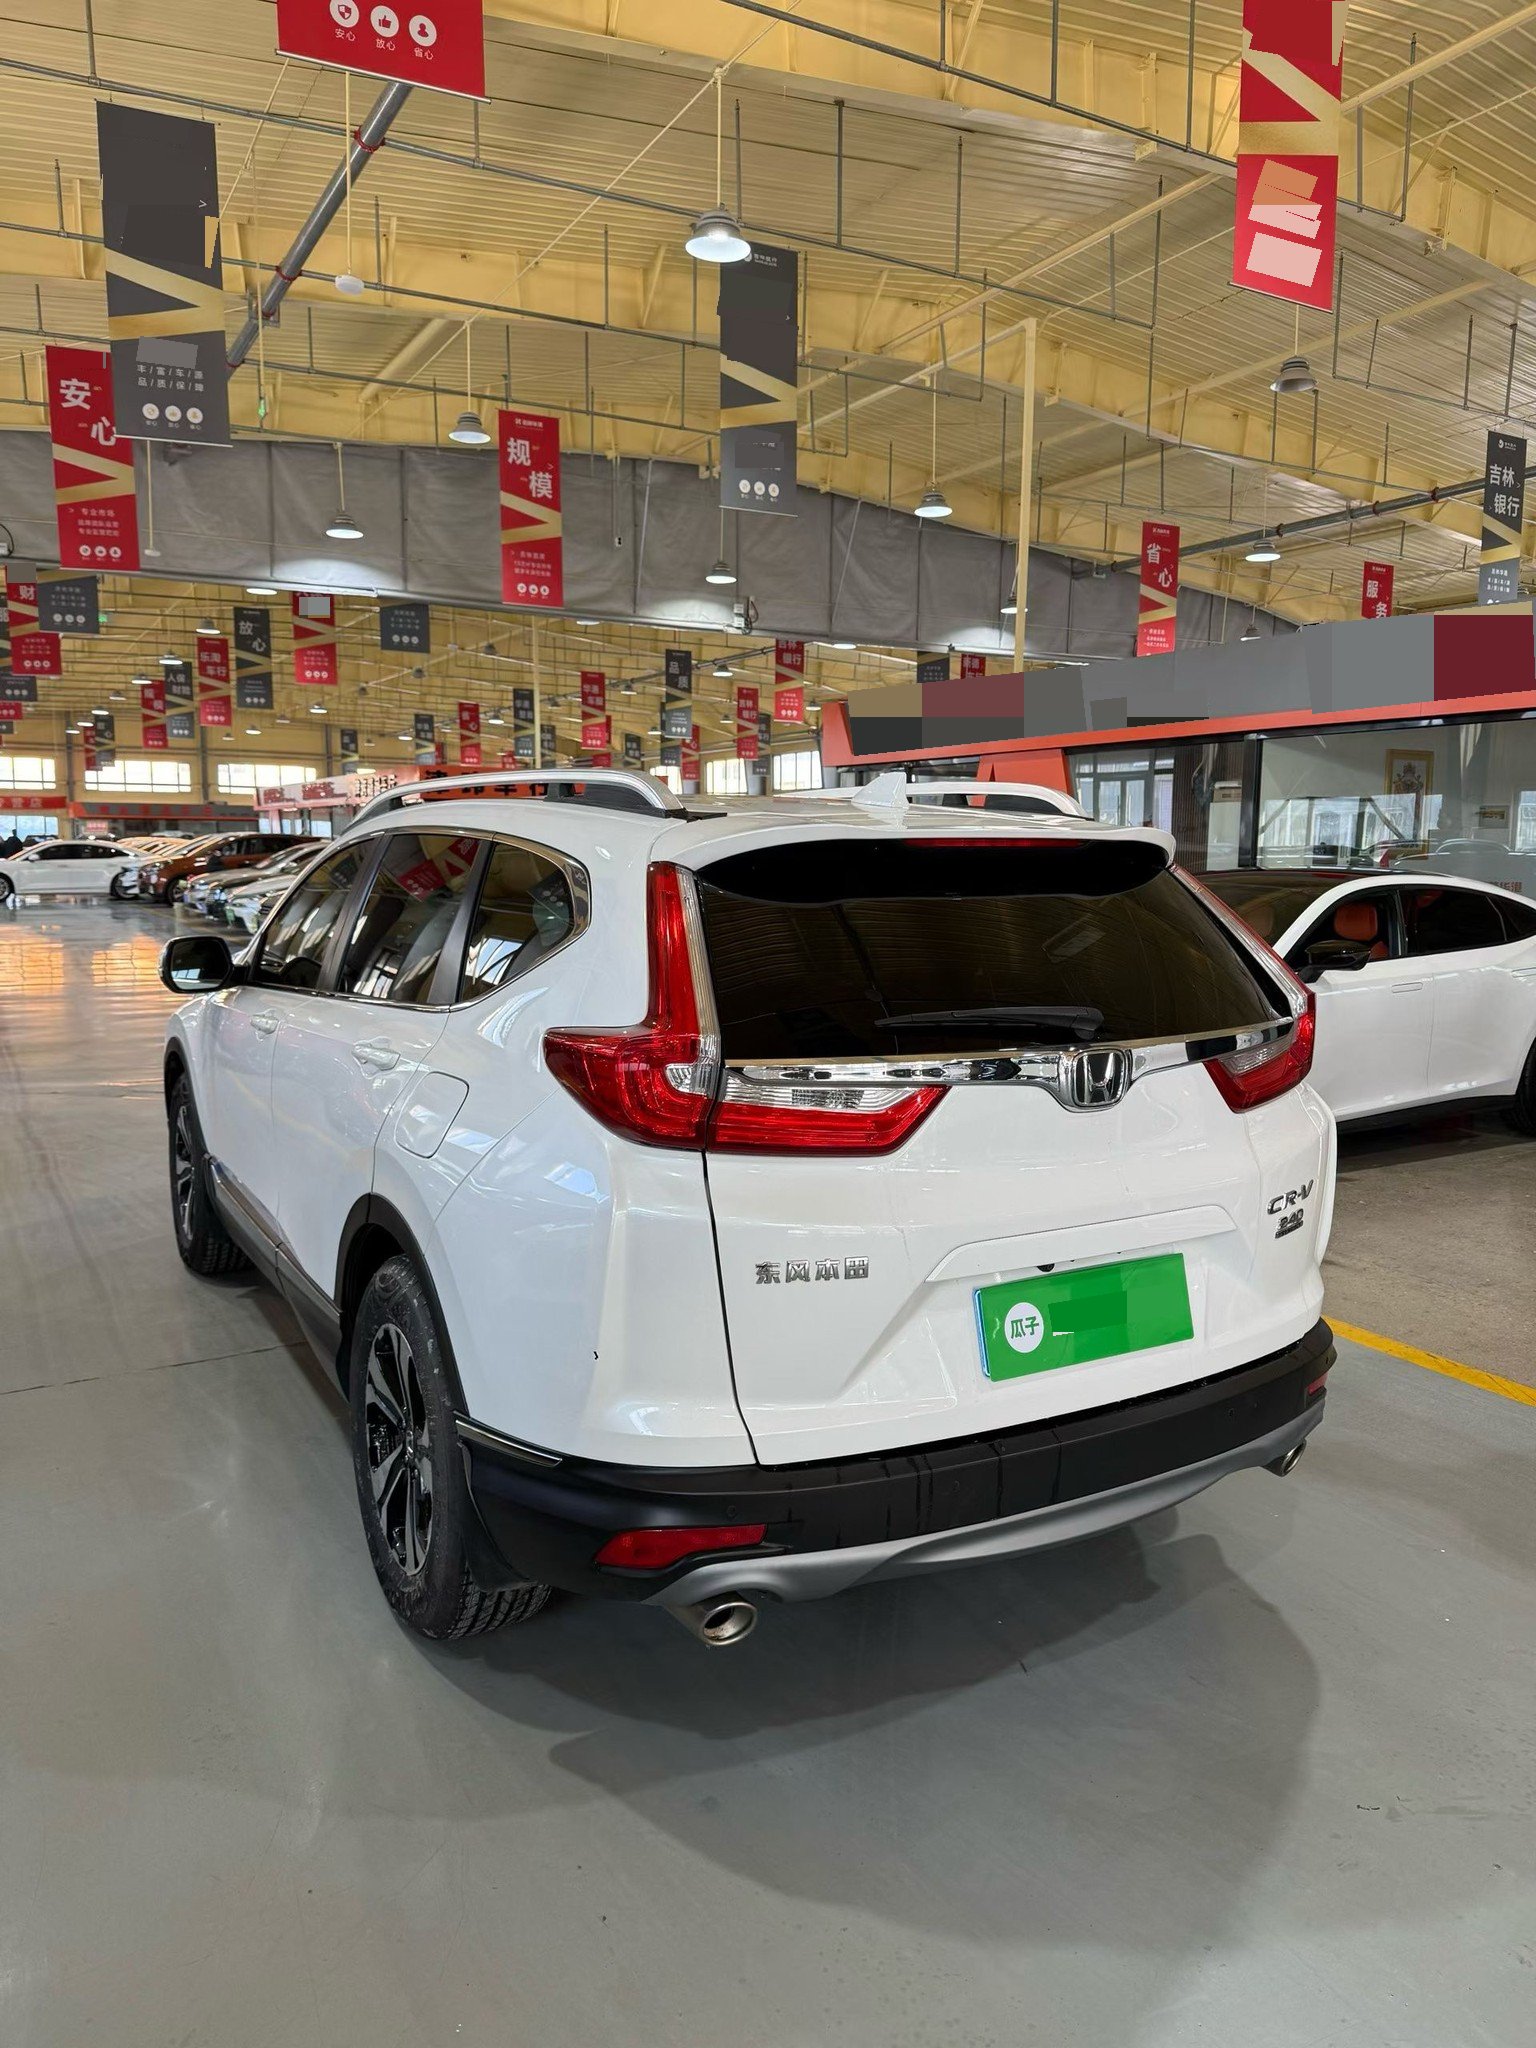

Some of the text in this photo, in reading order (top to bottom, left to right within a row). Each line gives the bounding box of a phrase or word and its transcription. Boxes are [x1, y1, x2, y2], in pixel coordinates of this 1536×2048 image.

[335, 28, 434, 60] 安心 放心 省心
[59, 378, 117, 446] 安心
[507, 437, 553, 499] 规模
[1489, 463, 1516, 488] 吉林
[1493, 492, 1520, 518] 银行
[1147, 542, 1173, 588] 省心
[1366, 579, 1388, 618] 服务
[238, 620, 267, 652] 放心
[669, 661, 689, 689] 品质
[1267, 1179, 1314, 1215] CR-V
[755, 1256, 869, 1285] 东风本田
[1010, 1315, 1040, 1339] 瓜子
